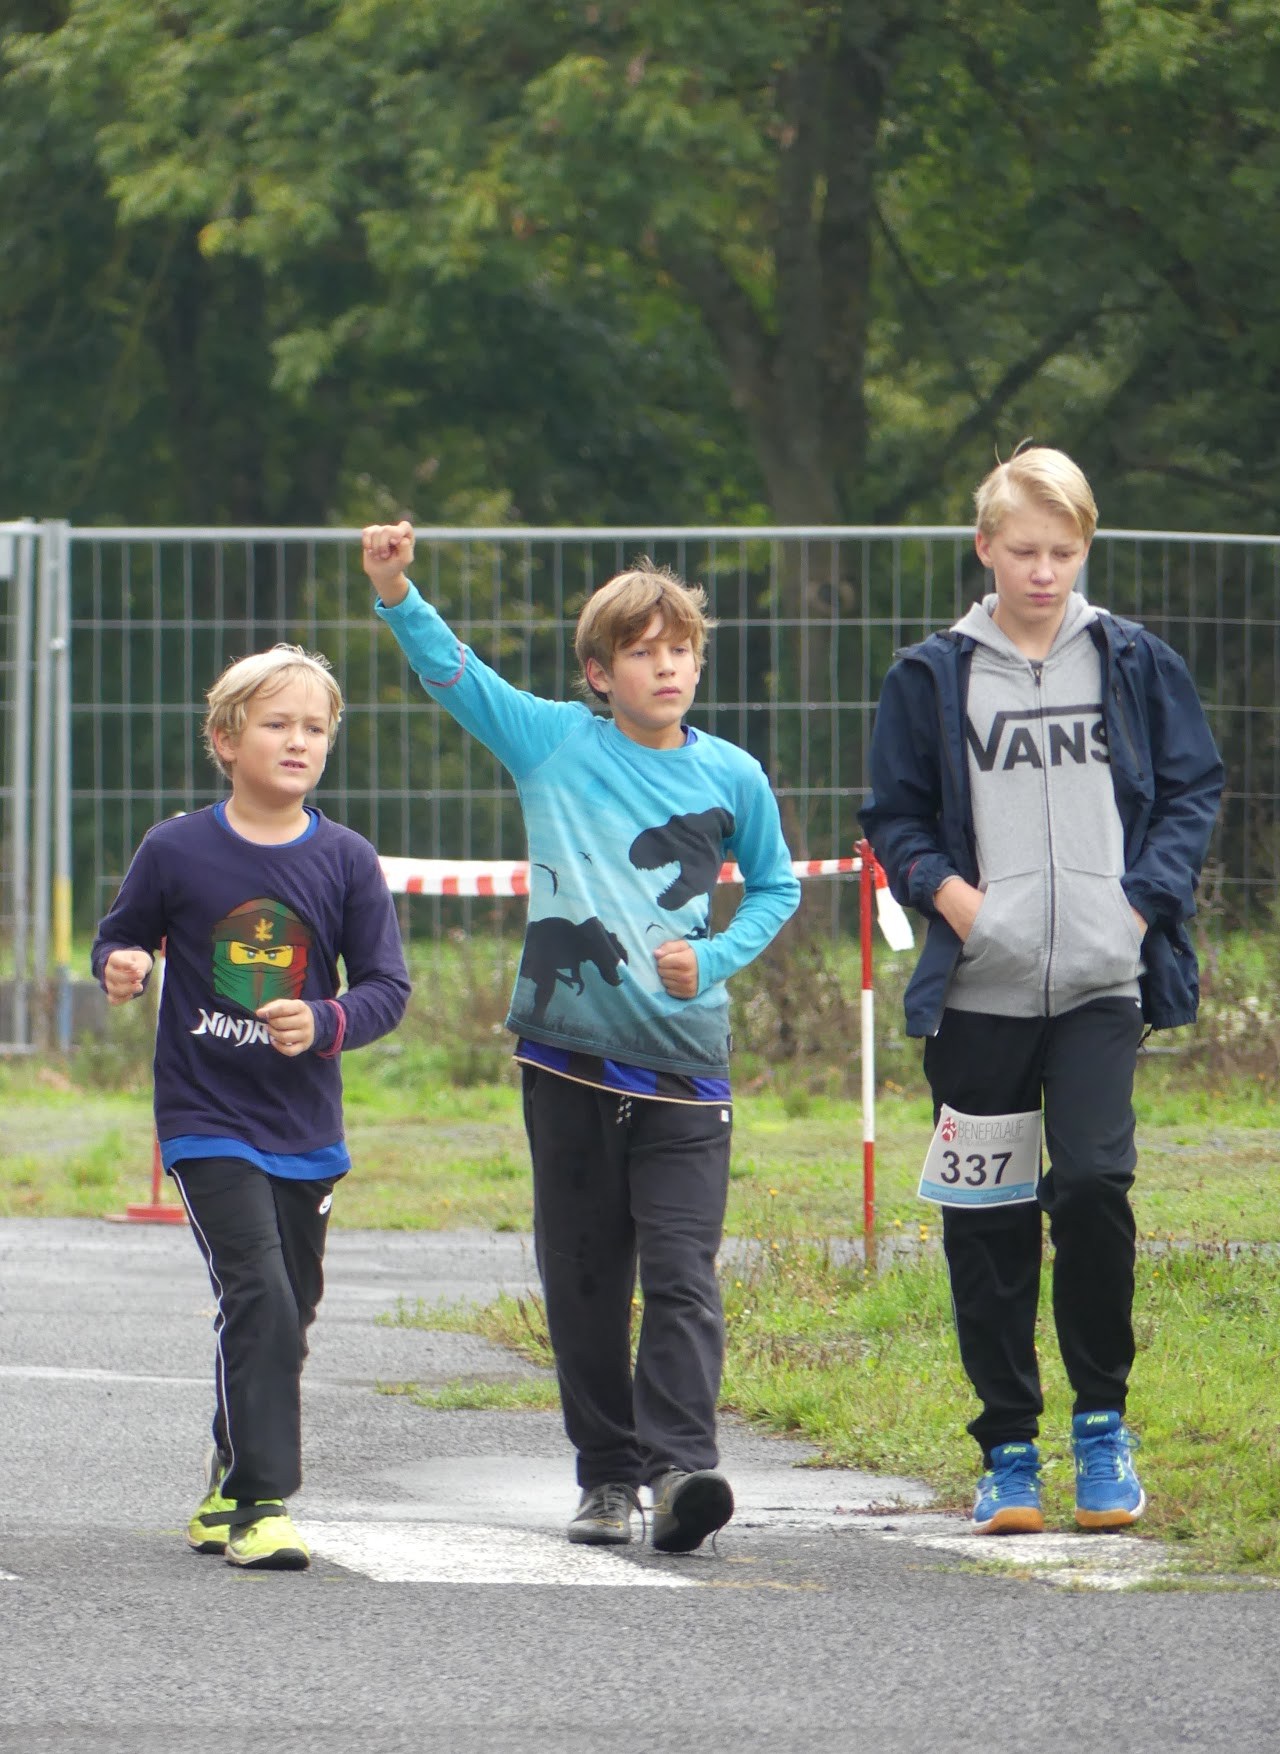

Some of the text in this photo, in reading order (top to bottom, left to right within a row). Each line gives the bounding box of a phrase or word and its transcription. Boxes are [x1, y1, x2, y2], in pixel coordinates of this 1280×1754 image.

[966, 704, 1111, 772] VANS
[190, 1008, 274, 1047] NINJA
[957, 1119, 1025, 1140] BENEFIZLAUF
[940, 1150, 1013, 1186] 337
